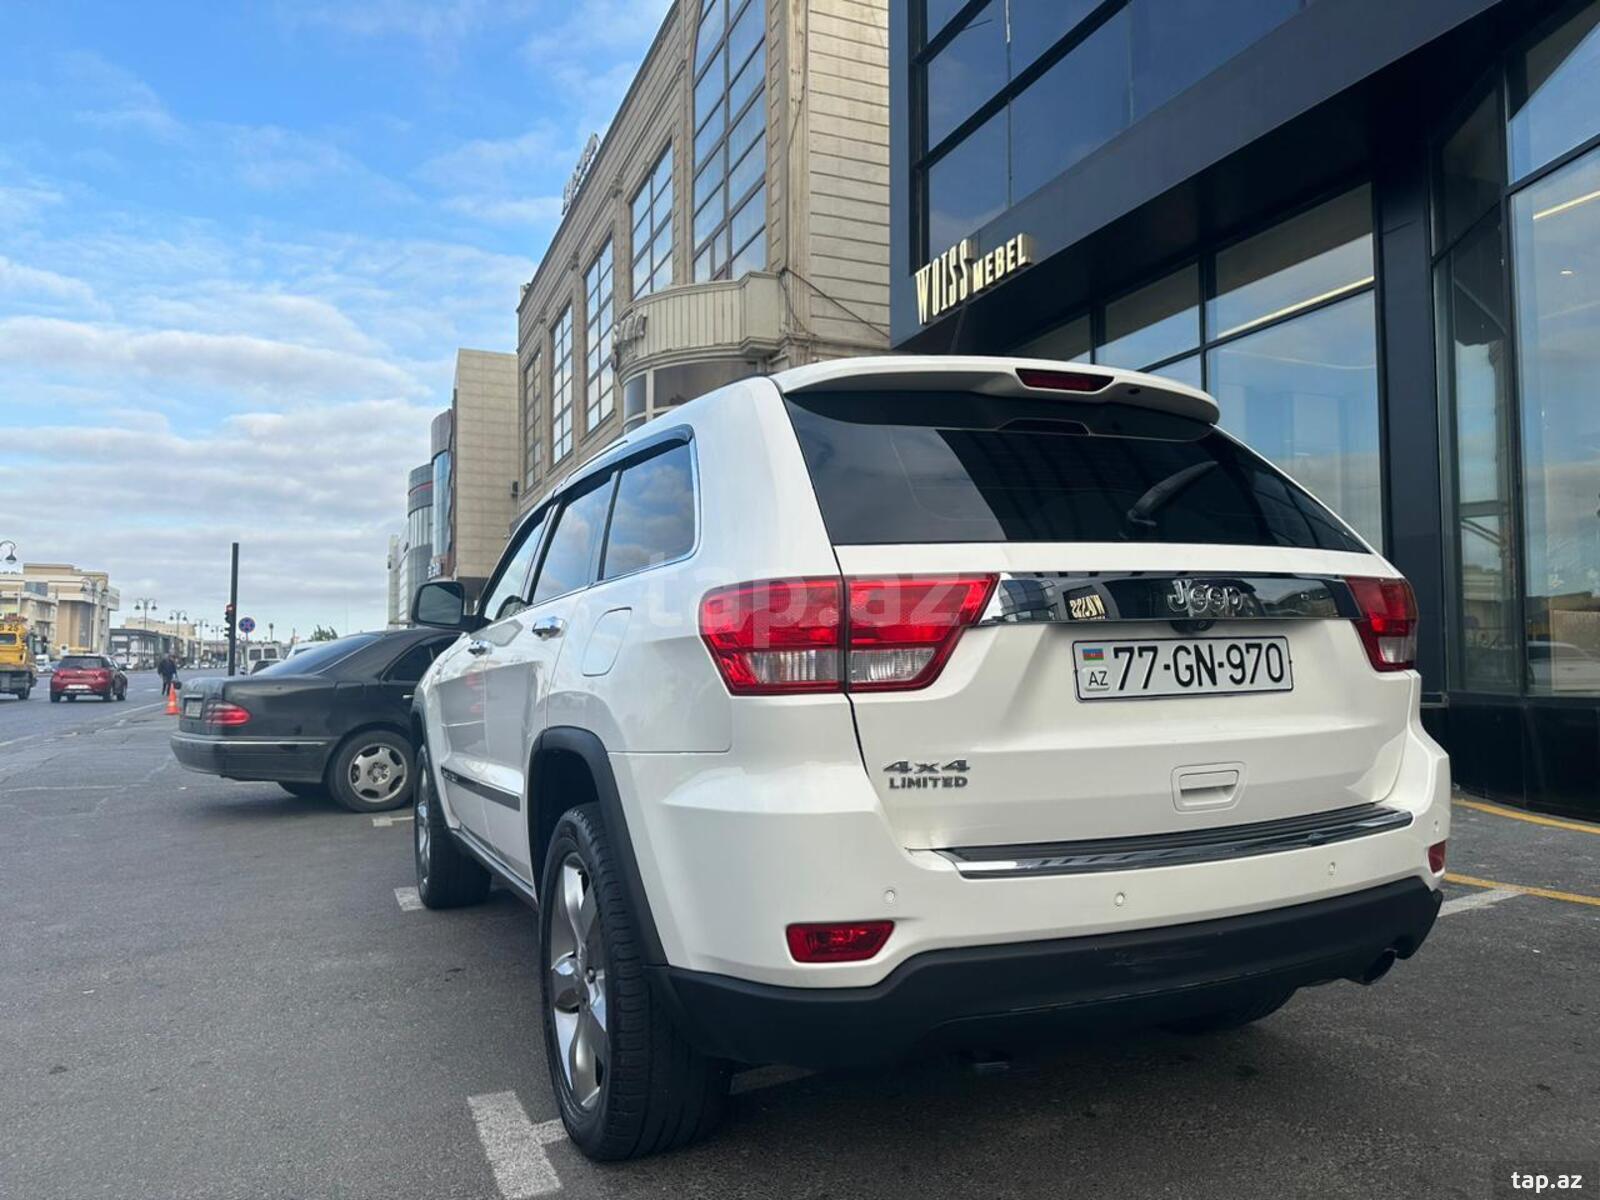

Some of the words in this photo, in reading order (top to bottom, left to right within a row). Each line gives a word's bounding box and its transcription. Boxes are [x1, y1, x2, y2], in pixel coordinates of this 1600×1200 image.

[973, 232, 1028, 293] MEBEL
[1167, 580, 1244, 616] Jeep
[1087, 671, 1109, 687] AZ
[1113, 642, 1284, 691] 77-GN-970
[888, 776, 968, 789] LIMITED
